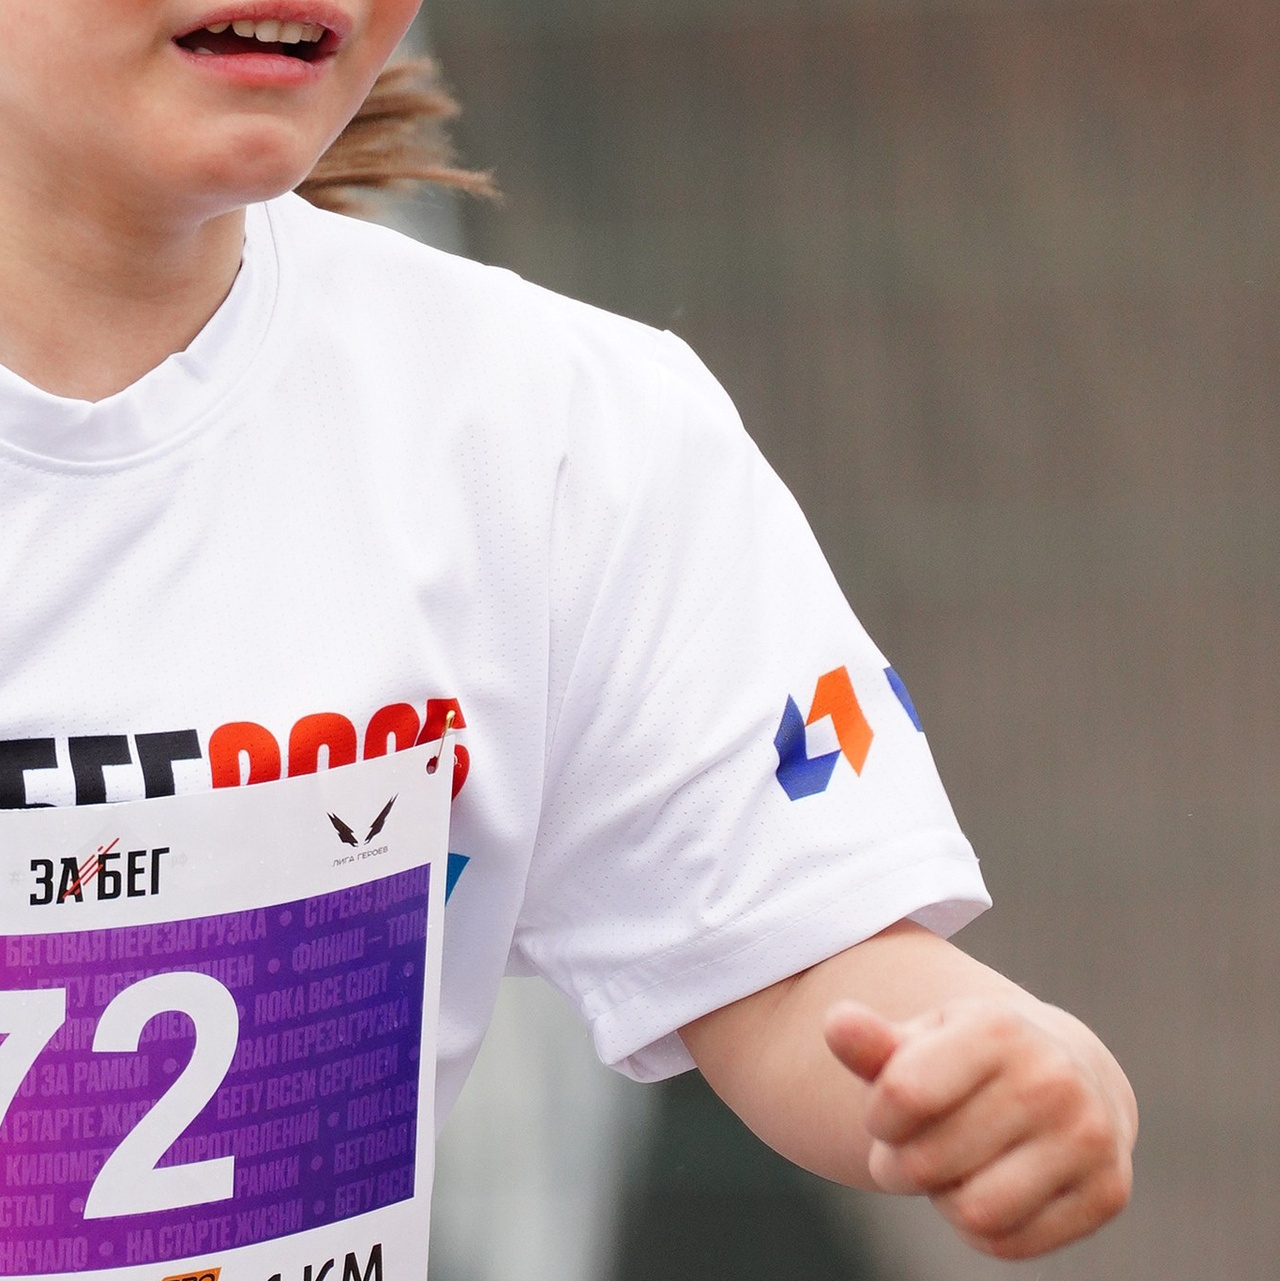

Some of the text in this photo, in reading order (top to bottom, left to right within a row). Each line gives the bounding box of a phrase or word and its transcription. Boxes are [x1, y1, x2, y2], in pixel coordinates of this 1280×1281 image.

[332, 845, 389, 868] ЛИГА ГЕРОЕВ
[110, 907, 267, 961] ПЕРЕЗАГРУЗКА
[292, 926, 366, 975] ФИНИШ
[254, 984, 306, 1026] ПОКА
[308, 975, 344, 1014] ВСЕ
[345, 960, 391, 1004] СПЯТ
[13, 1106, 97, 1144] СТАРТЕ
[218, 1080, 263, 1121] БЕГУ
[266, 1068, 317, 1111] ВСЕМ
[319, 1043, 399, 1097] СЕРДЦЕМ
[40, 1062, 71, 1097] ЗА
[73, 1054, 149, 1094] РАМКИ
[347, 1086, 392, 1132] ПОКА
[235, 1154, 300, 1200] РАМКИ
[333, 1121, 408, 1176] БЕГОВАЯ
[125, 1228, 155, 1263] НА
[158, 1215, 233, 1259] СТАРТЕ
[233, 1197, 304, 1246] ЖИЗНИ
[334, 1172, 377, 1219] БЕГУ
